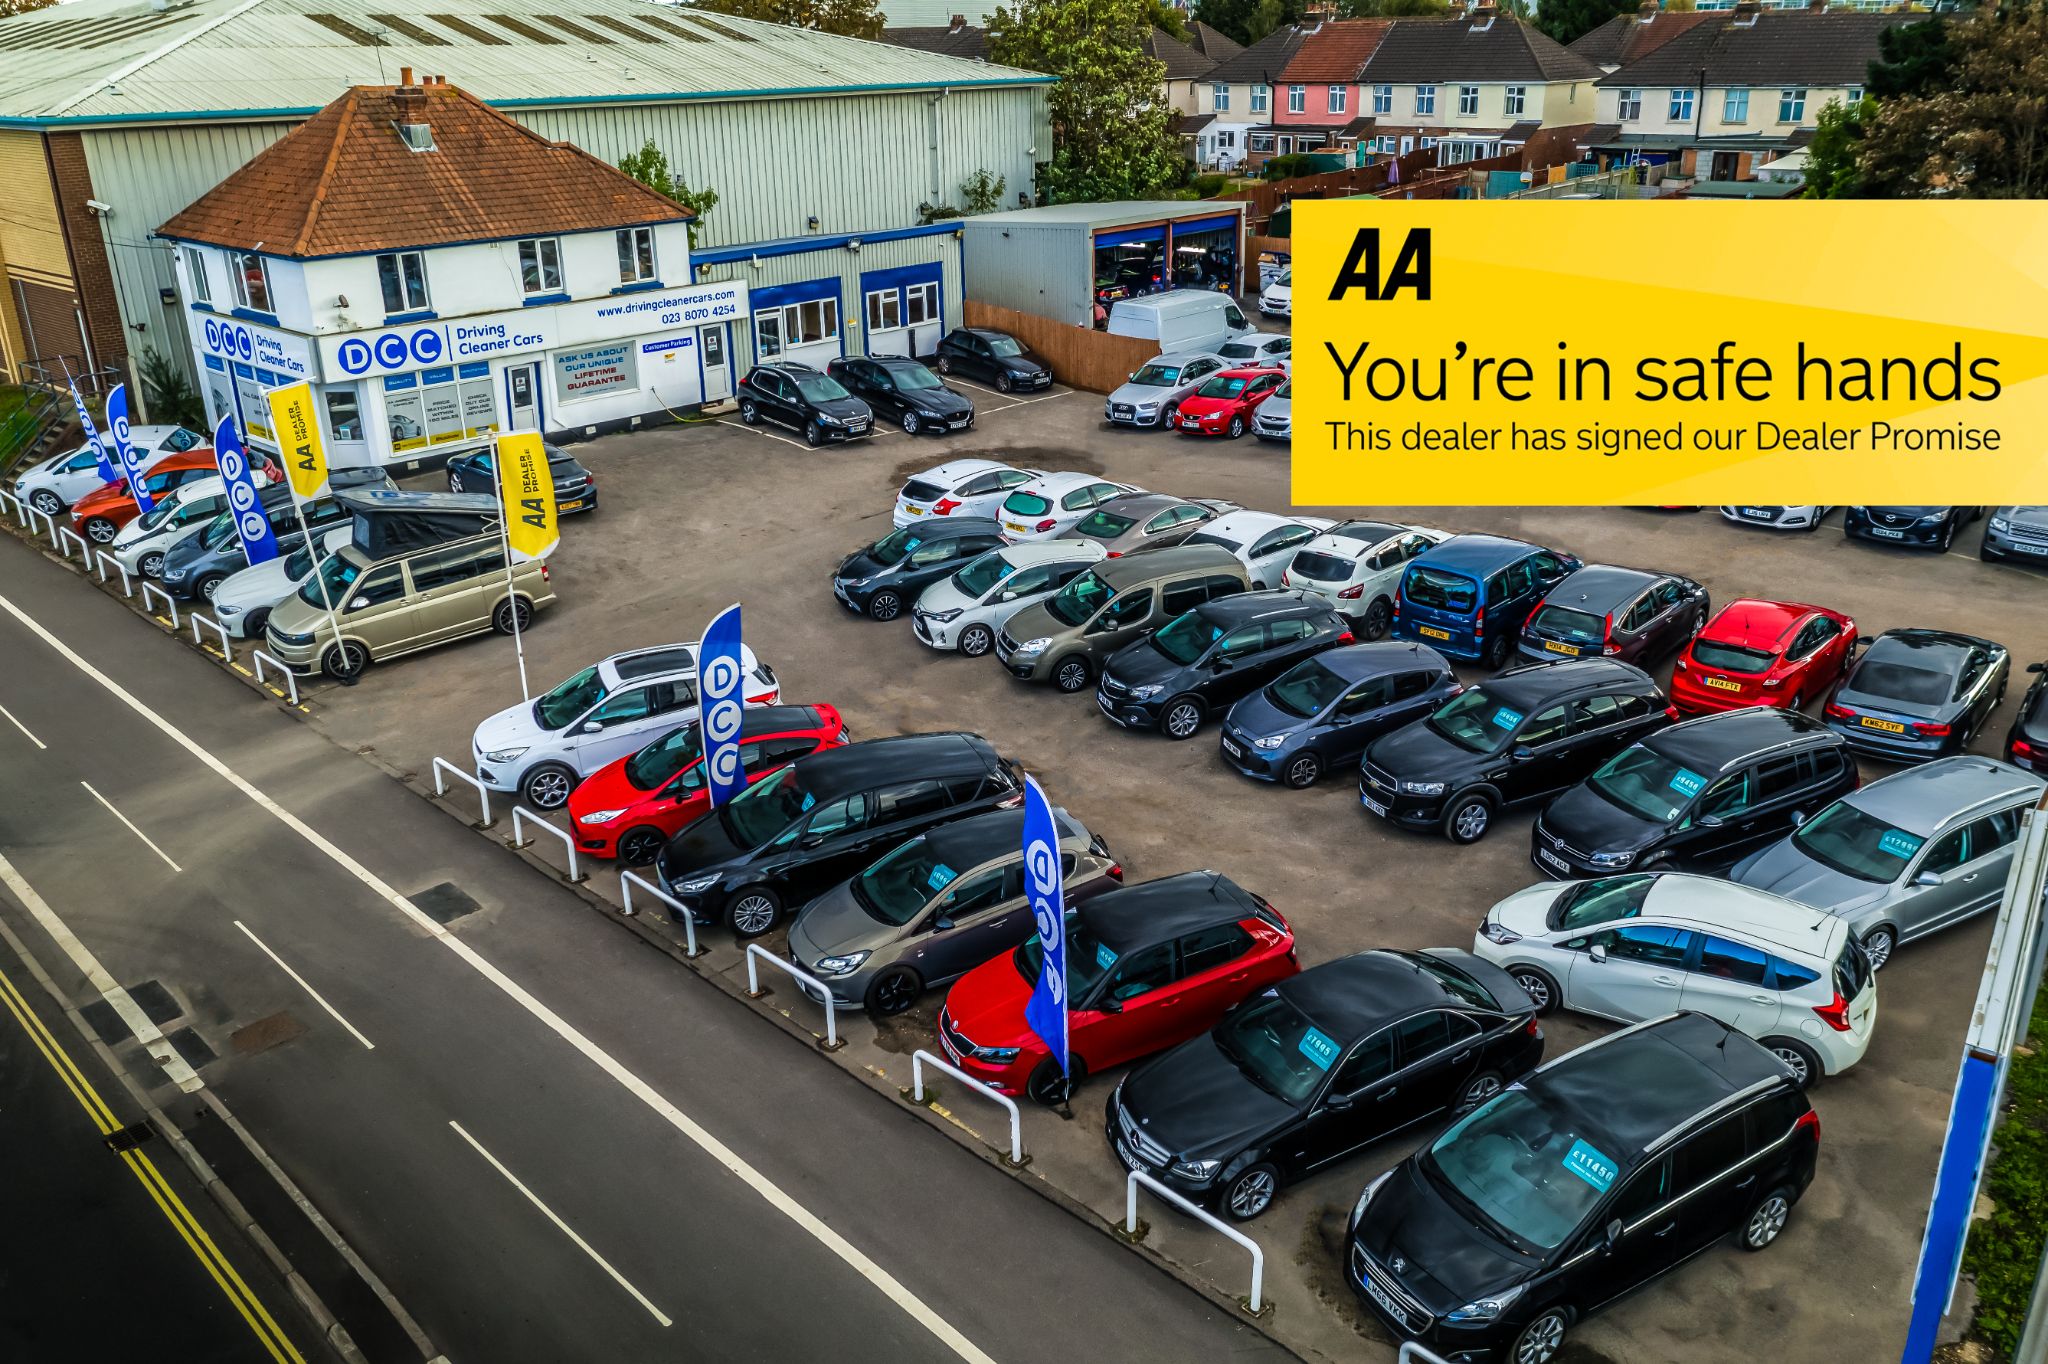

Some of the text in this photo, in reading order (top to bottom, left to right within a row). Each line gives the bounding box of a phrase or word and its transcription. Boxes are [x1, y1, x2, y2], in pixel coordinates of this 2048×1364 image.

[597, 290, 735, 317] www.drivingcleanercars.com
[662, 304, 736, 324] 023 8070 4254
[206, 320, 251, 359] DCC
[256, 334, 282, 356] Driving
[456, 324, 506, 340] Driving
[458, 332, 544, 355] Cleaner Cars
[644, 339, 691, 351] Customer Parking
[260, 350, 305, 373] Cleaner Cars
[342, 330, 440, 372] DCC
[558, 347, 629, 364] ASK US ABOUT
[565, 356, 624, 372] OUR UNIQUE
[567, 374, 626, 391] GUARANTEE
[574, 367, 617, 380] LIFETIME
[288, 407, 303, 442] DEALER
[294, 400, 309, 440] PROMISE
[295, 443, 317, 471] AA
[524, 448, 540, 492] PROMISE
[520, 455, 533, 493] DEALER
[224, 453, 263, 538] DCC
[520, 498, 547, 530] AA
[709, 660, 740, 782] DCC
[1572, 1150, 1615, 1182] £11450
